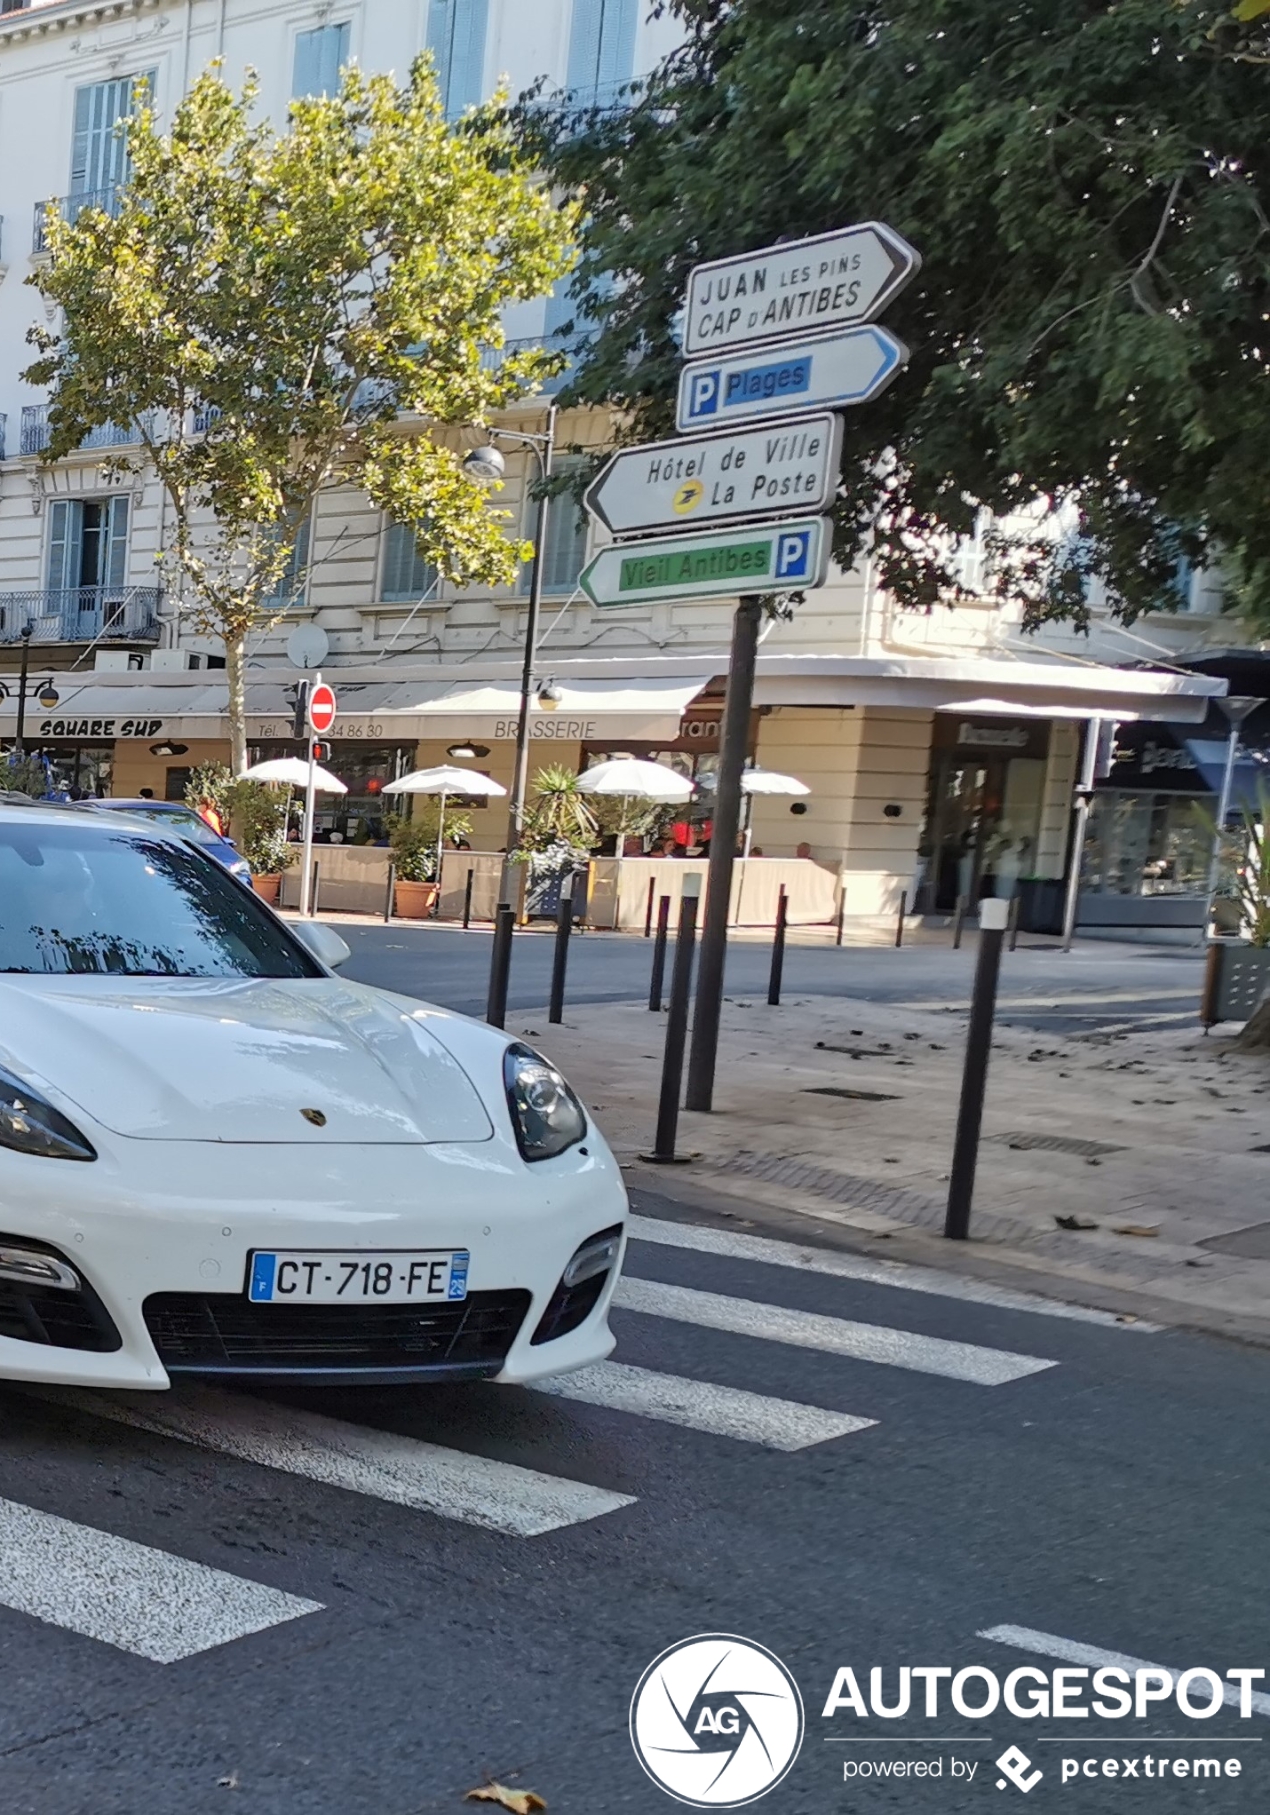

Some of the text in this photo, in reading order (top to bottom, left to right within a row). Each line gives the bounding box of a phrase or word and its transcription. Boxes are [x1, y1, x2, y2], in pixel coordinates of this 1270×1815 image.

[700, 253, 862, 305] JUAN LES PINS
[697, 307, 741, 338] CAP
[693, 366, 805, 413] P Plages
[646, 433, 821, 484] Hôtel de Ville
[711, 471, 817, 506] La Poste
[624, 548, 767, 586] Vieil Antibes
[780, 537, 803, 574] P
[39, 719, 163, 737] SQUARE SUD
[347, 724, 363, 737] 86
[366, 724, 383, 737] 30
[494, 720, 597, 739] BRSSERIE
[259, 1281, 267, 1293] F
[277, 1260, 448, 1296] CT-718-FE
